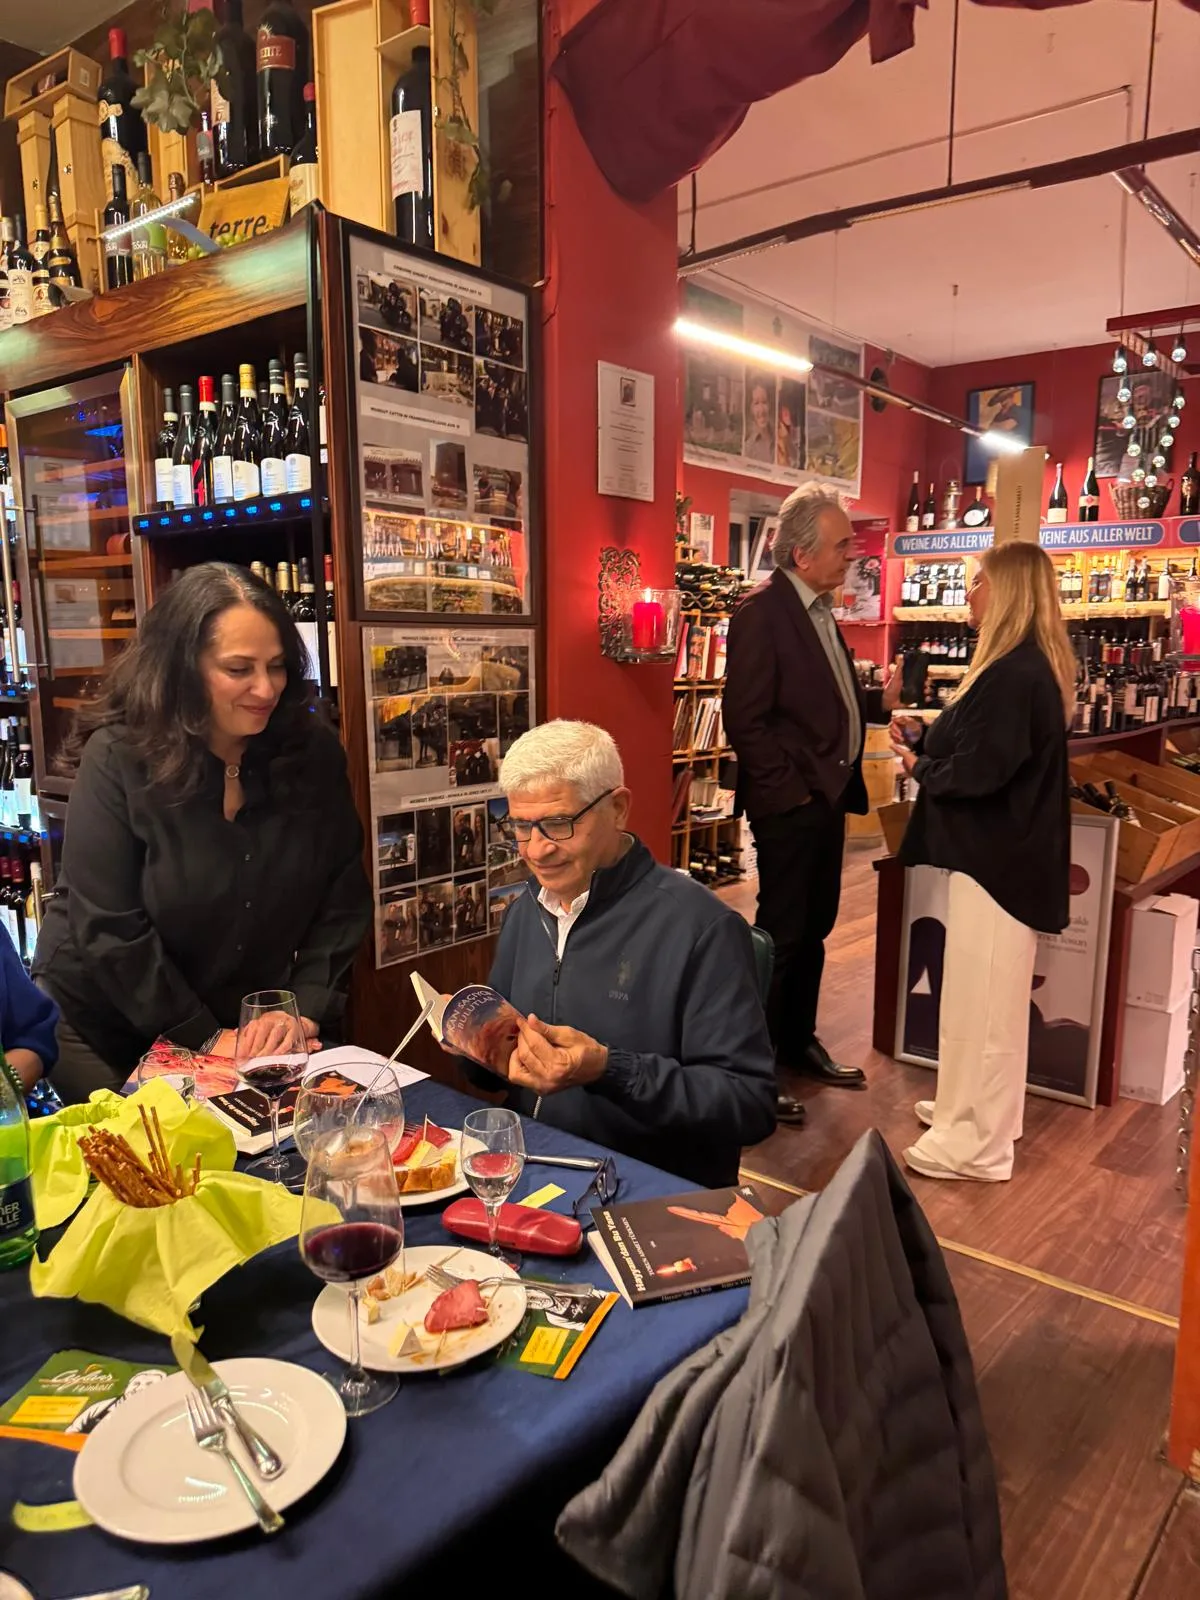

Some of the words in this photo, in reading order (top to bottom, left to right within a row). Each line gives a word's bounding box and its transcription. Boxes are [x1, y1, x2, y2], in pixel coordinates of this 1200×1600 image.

[210, 215, 267, 239] terre
[902, 538, 930, 551] WEINE
[931, 535, 949, 550] AUS
[950, 533, 978, 548] ALLER
[978, 532, 994, 547] WE
[1068, 529, 1089, 543] AUS
[1091, 528, 1123, 543] ALLER
[1124, 526, 1154, 541] WELT
[446, 1009, 460, 1032] KAN
[602, 1210, 617, 1232] Yana
[612, 1229, 623, 1242] Bu
[617, 1240, 646, 1292] Hayyam'dan
